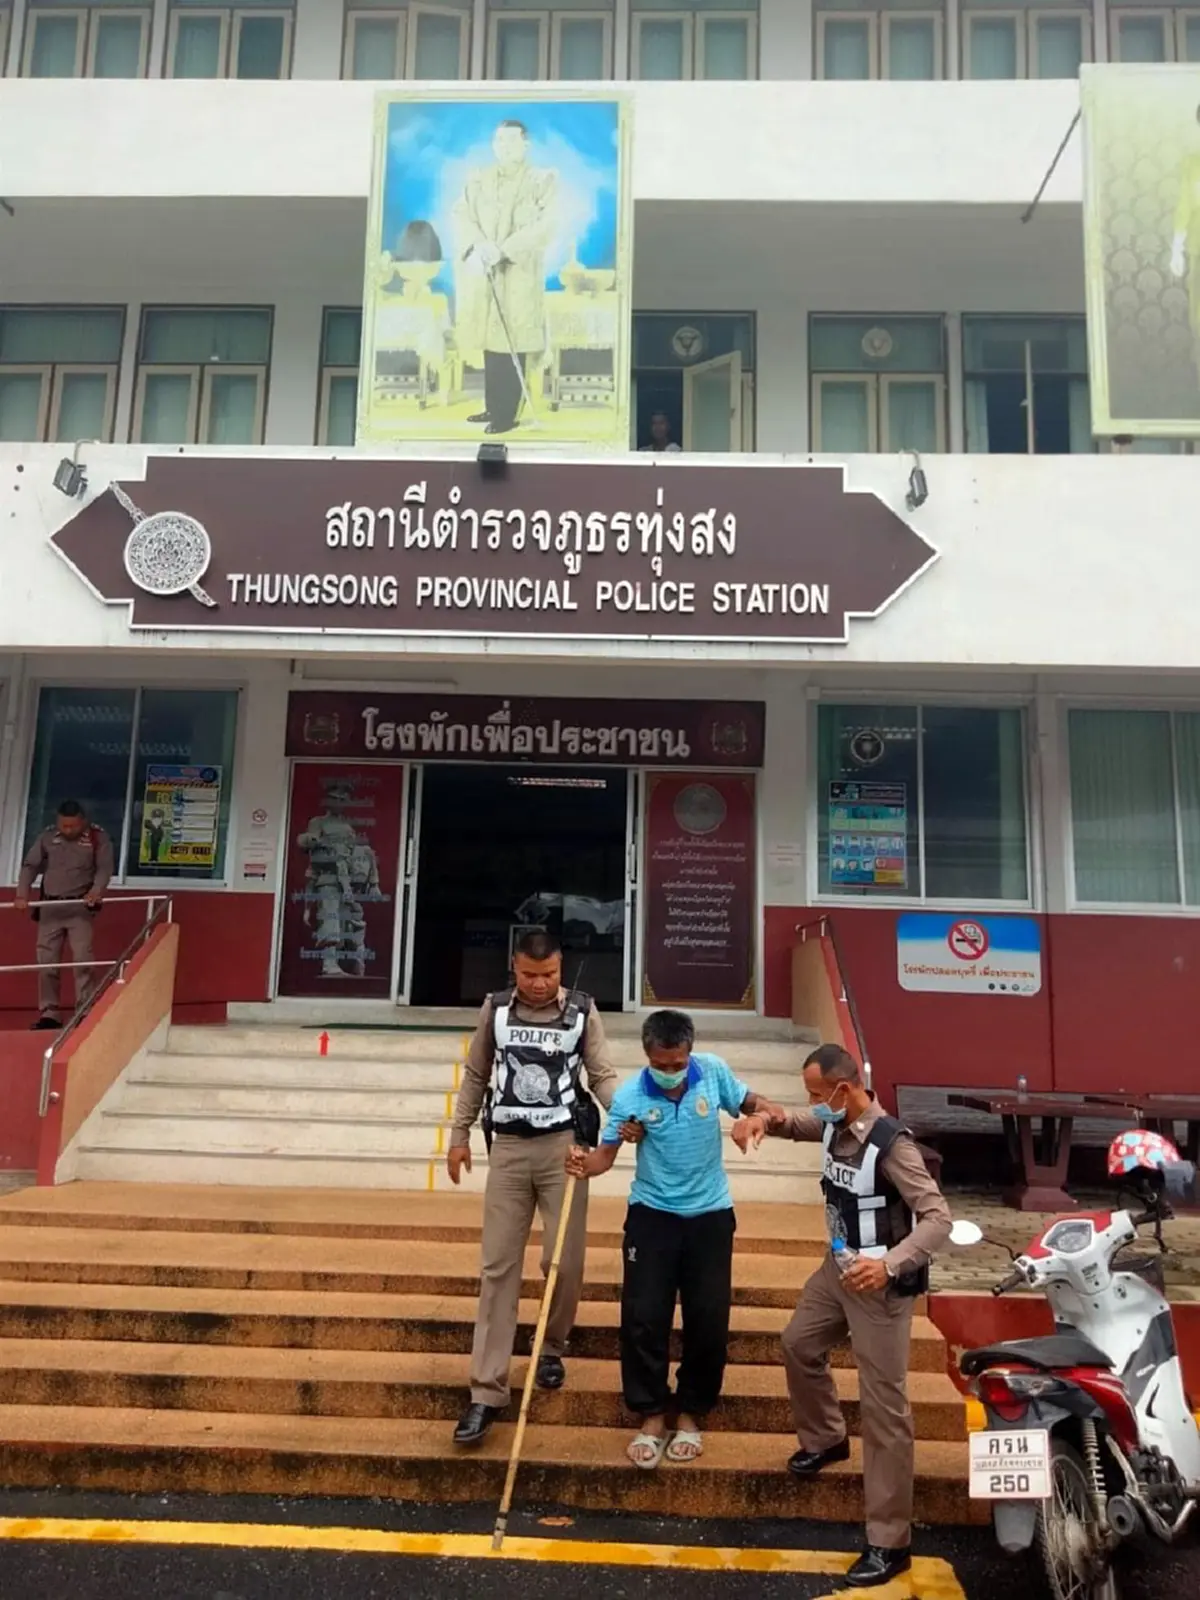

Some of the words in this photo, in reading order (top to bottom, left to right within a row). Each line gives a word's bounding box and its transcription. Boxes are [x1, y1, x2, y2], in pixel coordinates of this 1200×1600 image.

[325, 480, 738, 576] สถานีตำรวจภูธรทุ่งสง
[227, 573, 398, 607] THUNGSONG
[416, 577, 578, 611] PROVINCIAL
[595, 581, 695, 613] POLICE
[712, 583, 830, 614] STATION
[362, 701, 691, 757] โรงพักเพื่อประชาชน
[509, 1029, 563, 1046] POLICE
[990, 1474, 1029, 1493] 250
